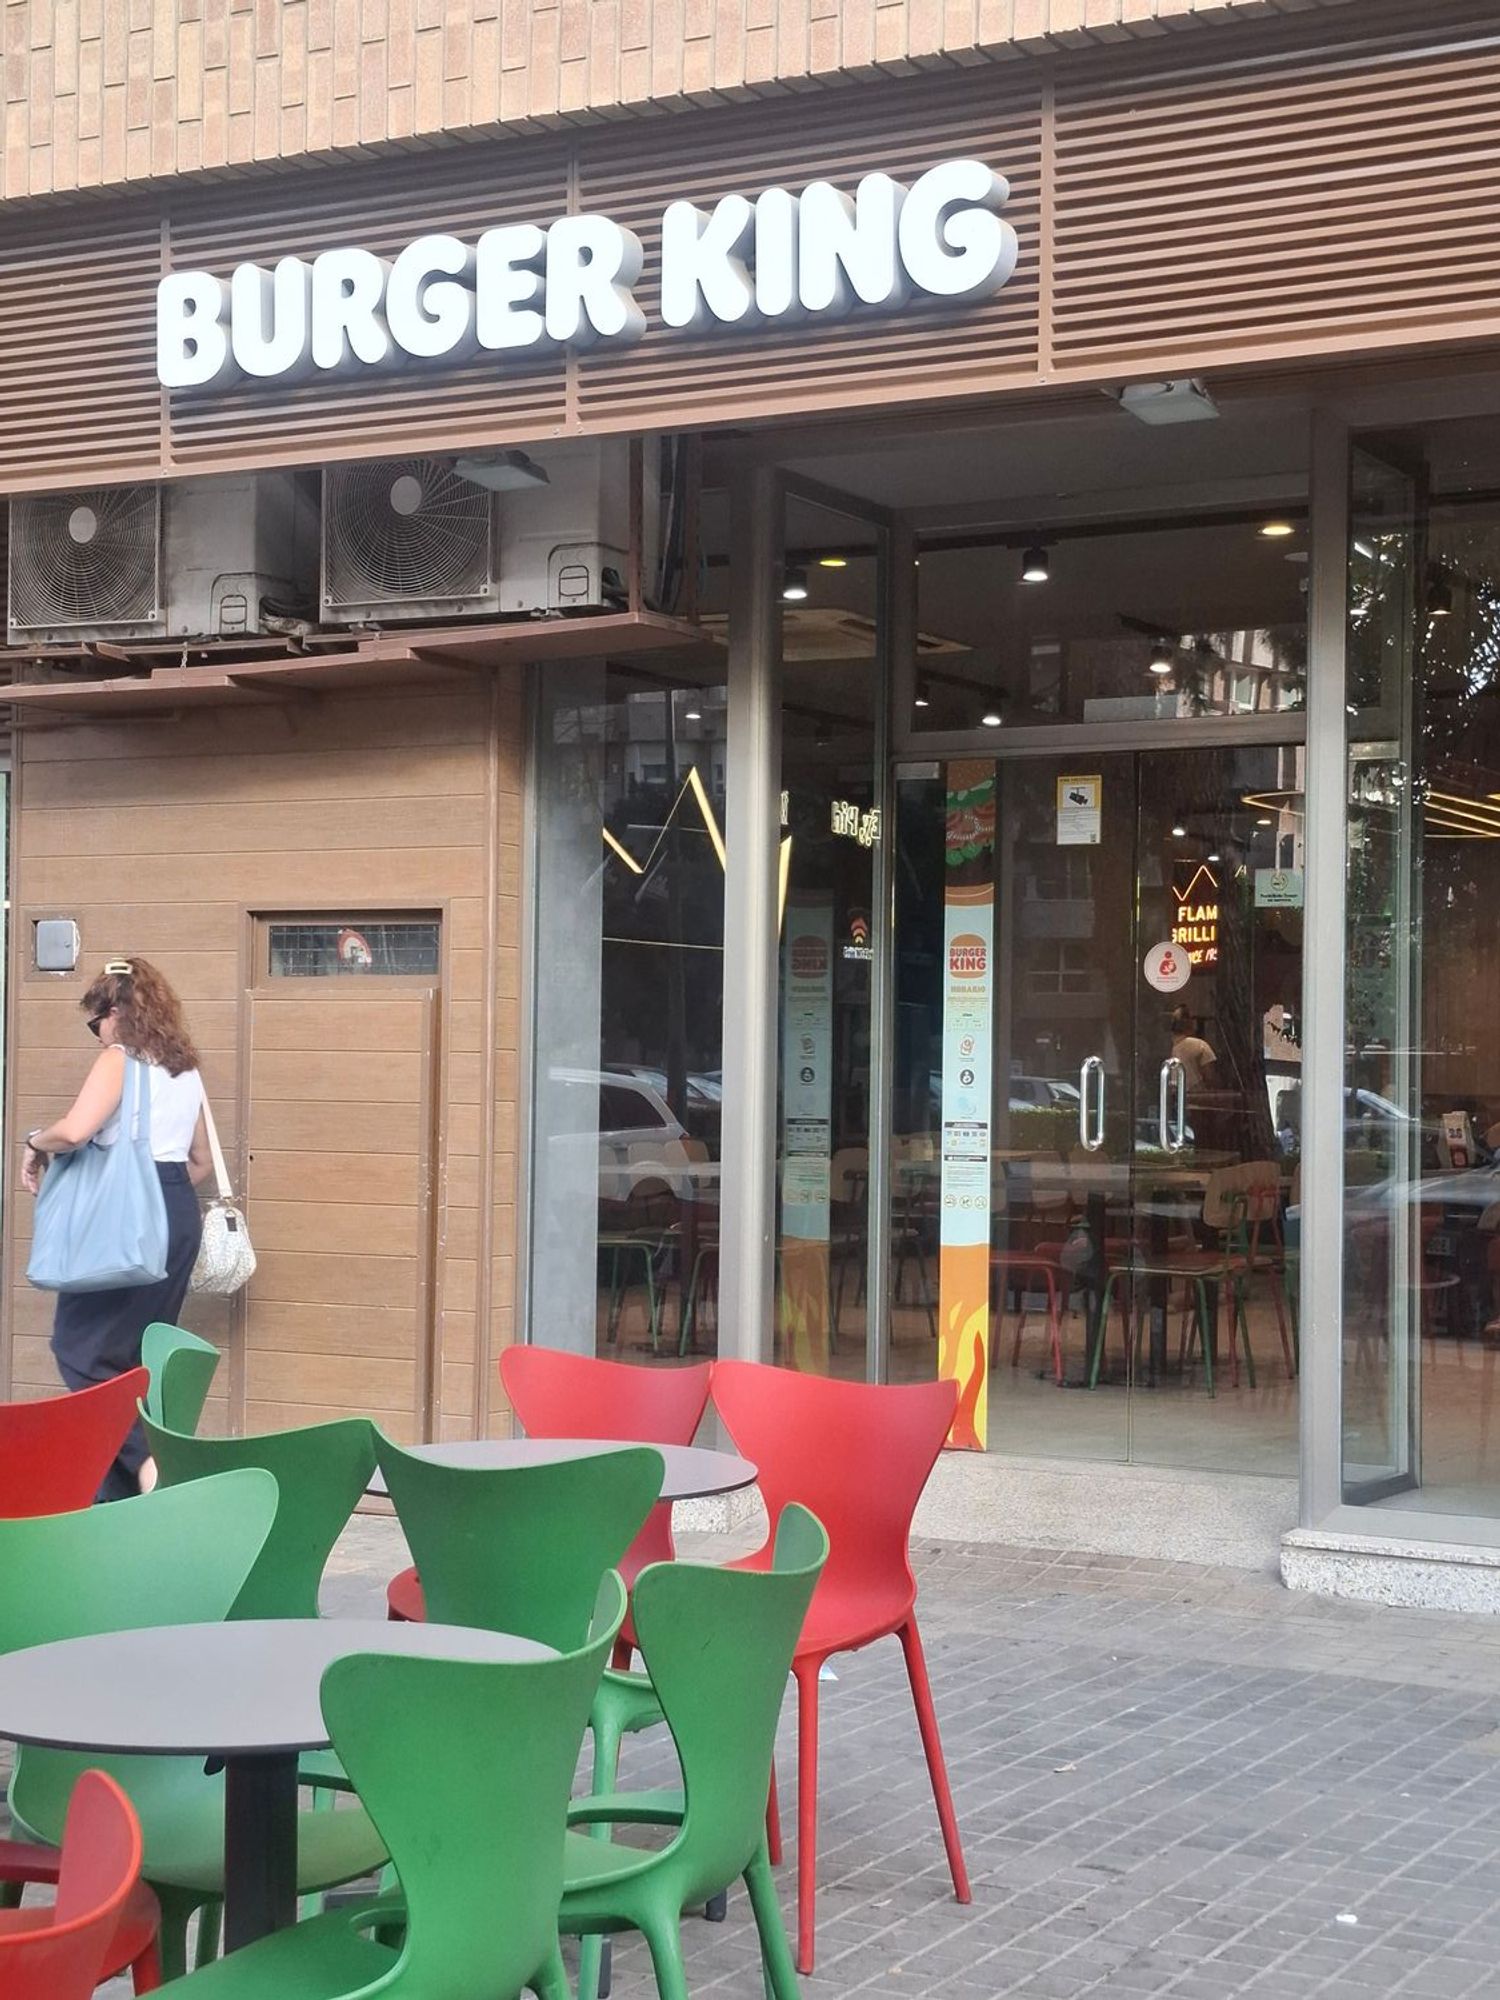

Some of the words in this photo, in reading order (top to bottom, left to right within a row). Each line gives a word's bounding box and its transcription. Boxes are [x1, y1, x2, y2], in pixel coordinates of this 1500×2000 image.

[156, 213, 645, 388] BURGER
[660, 158, 1019, 328] KING
[949, 947, 987, 957] BURGER
[949, 957, 987, 971] KING
